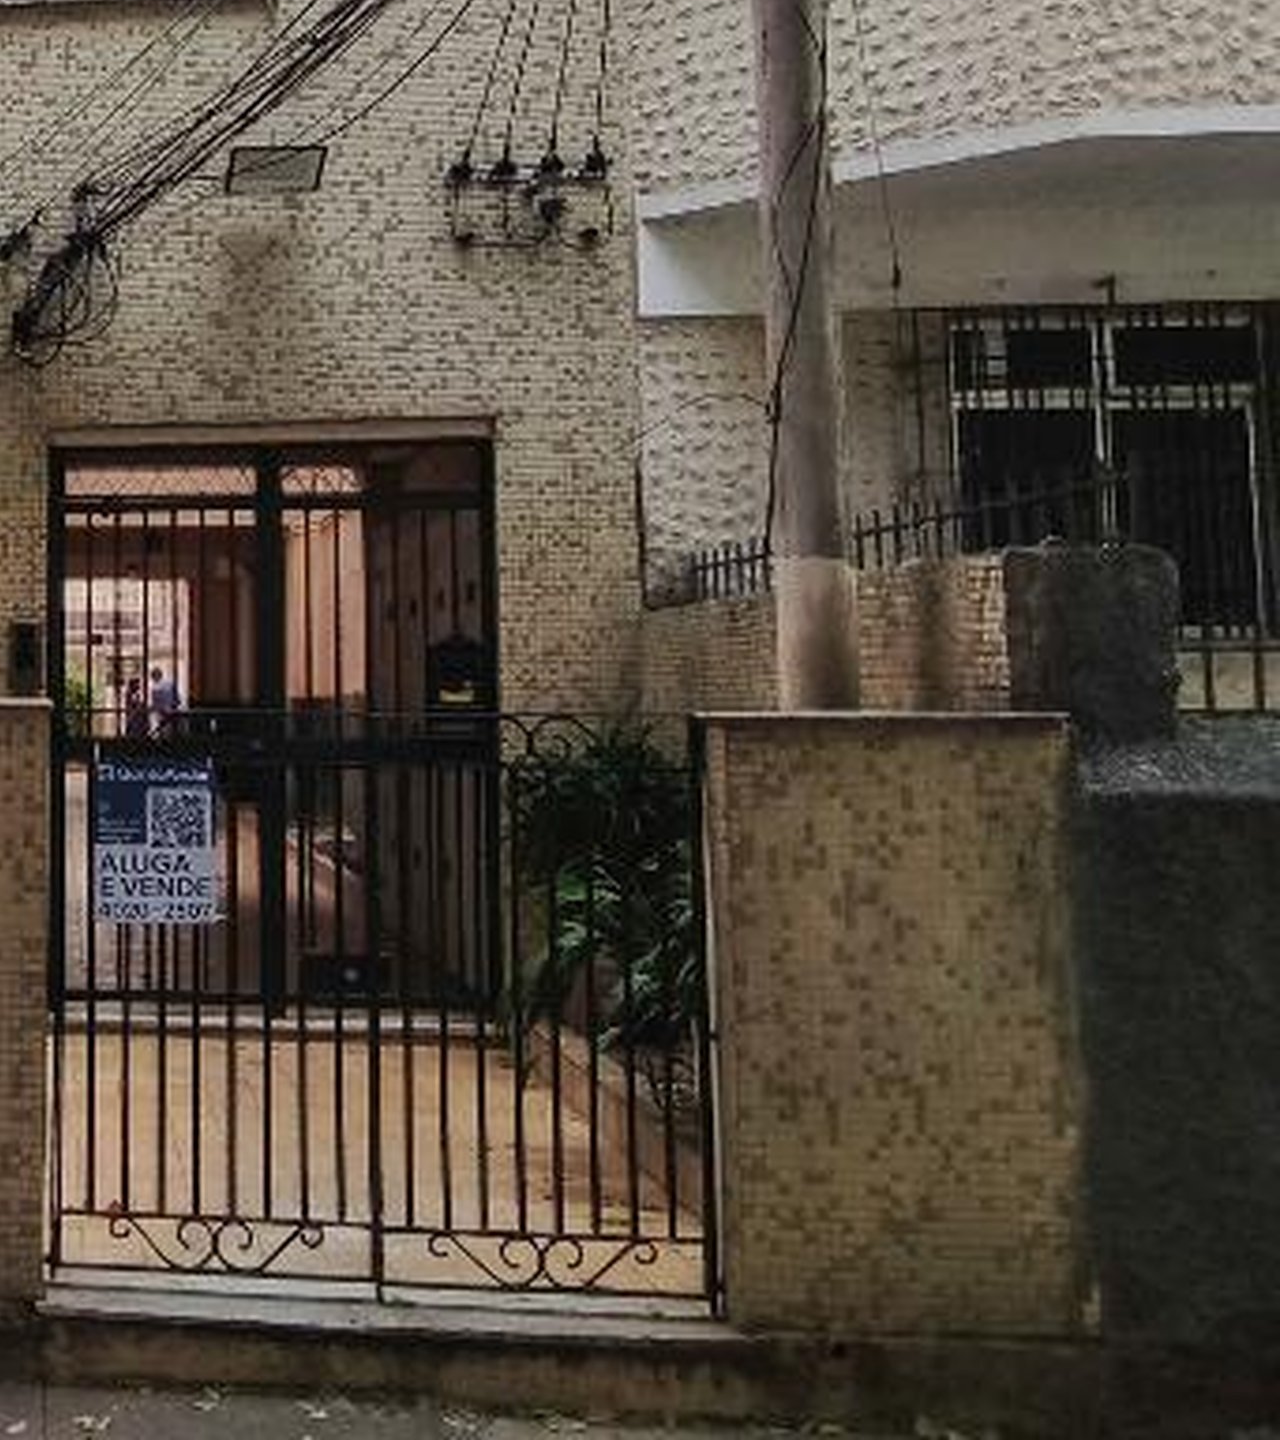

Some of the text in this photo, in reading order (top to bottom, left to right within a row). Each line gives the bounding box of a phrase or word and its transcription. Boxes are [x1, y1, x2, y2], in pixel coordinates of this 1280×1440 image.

[101, 852, 192, 874] ALUGA
[101, 876, 211, 897] E VENDE
